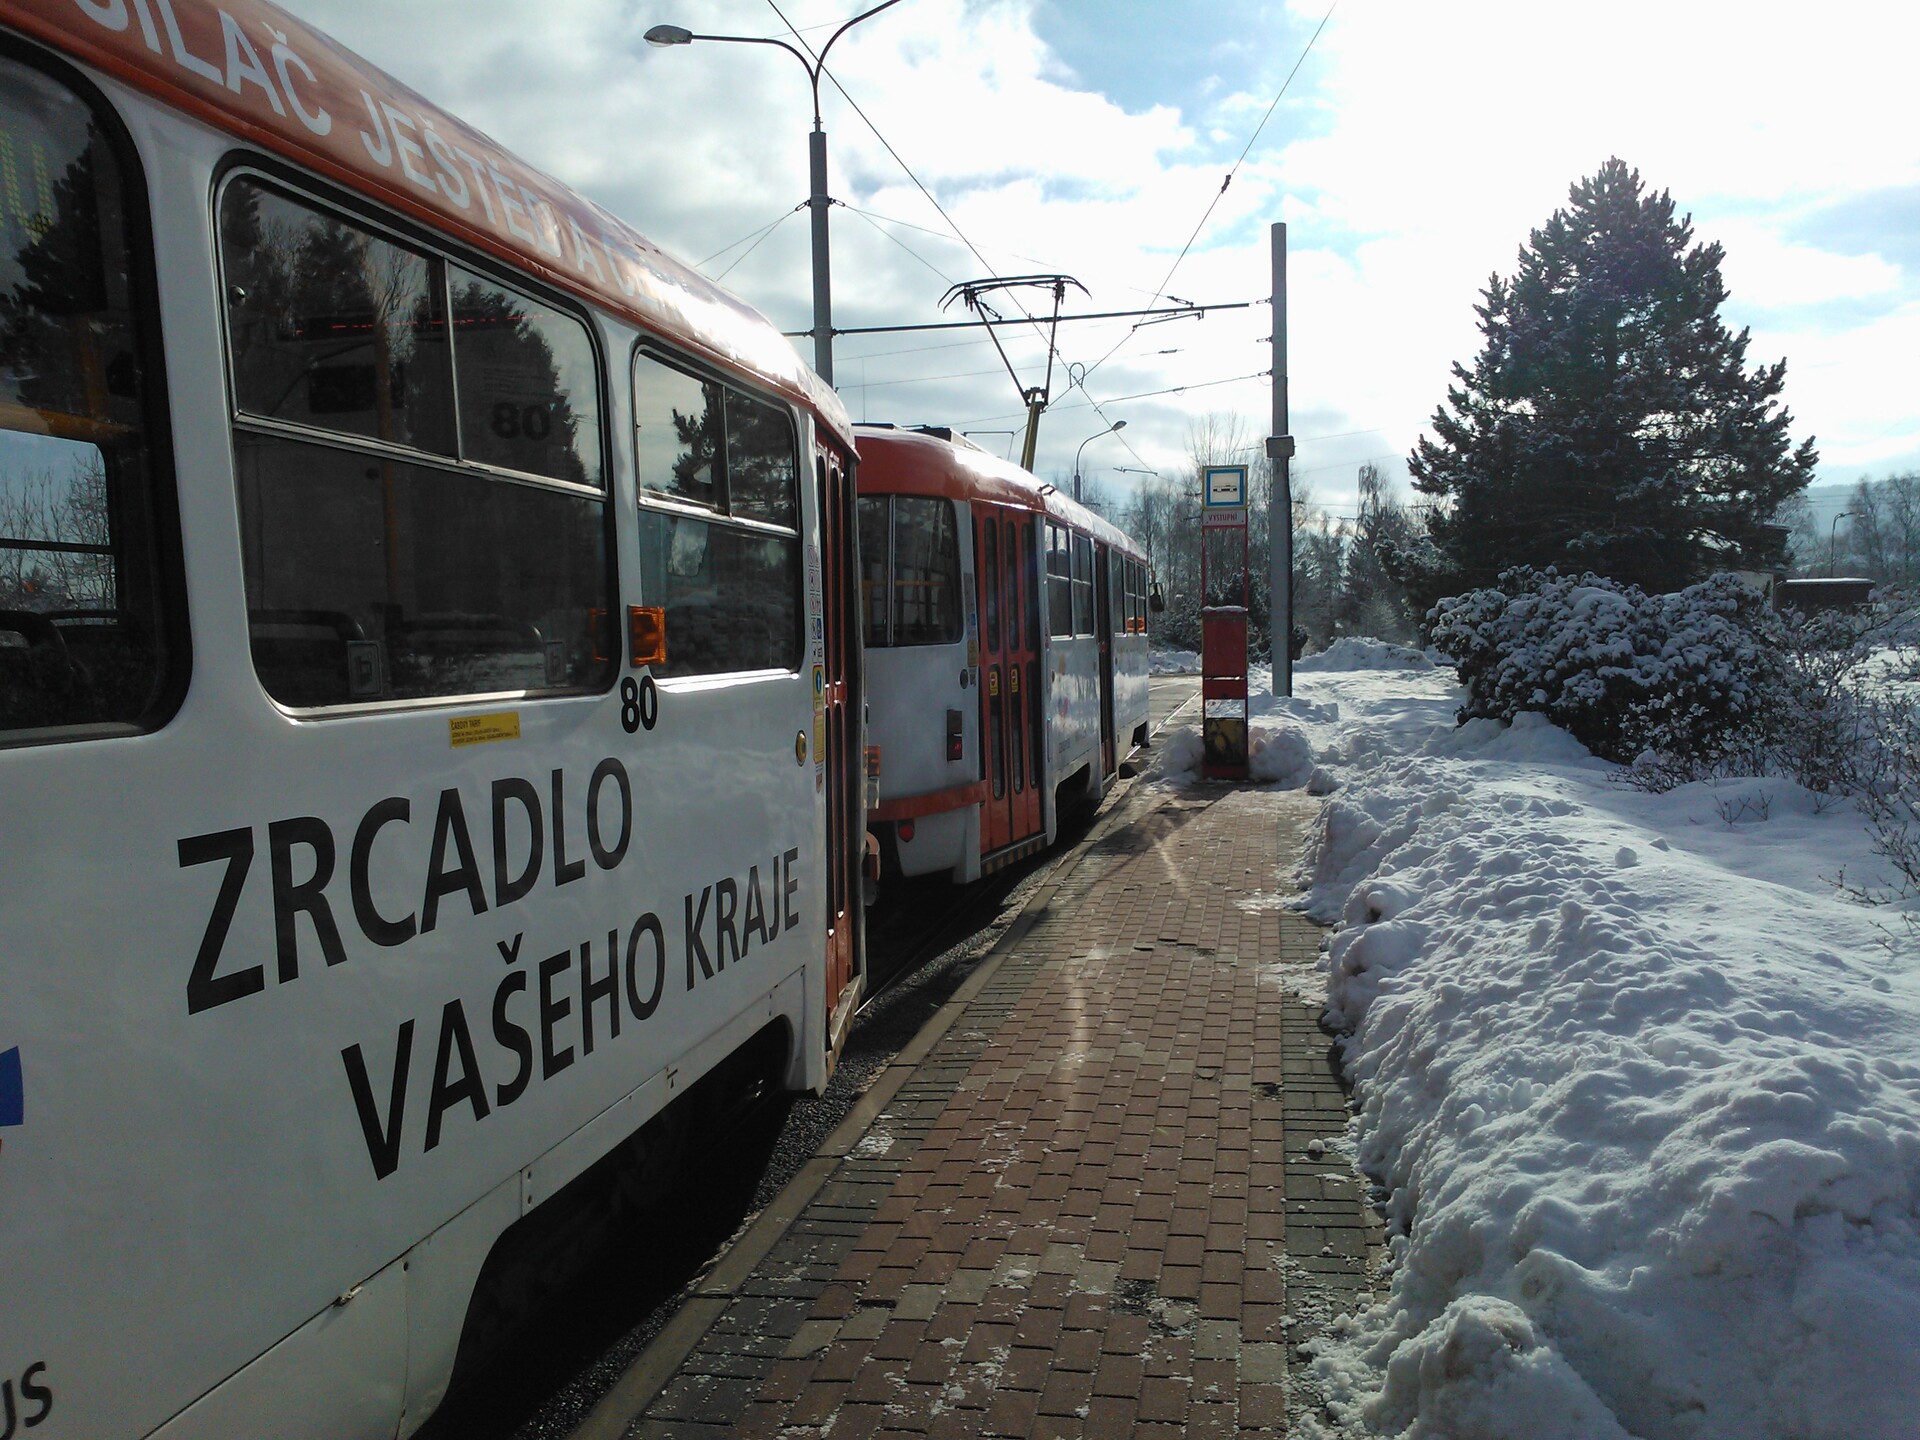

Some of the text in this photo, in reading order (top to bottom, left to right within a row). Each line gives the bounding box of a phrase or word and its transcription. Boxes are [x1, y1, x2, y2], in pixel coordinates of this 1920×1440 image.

[360, 89, 562, 258] JEŠTĚD
[491, 402, 551, 441] 80
[621, 677, 657, 734] 80
[177, 758, 632, 1015] ZRCADLO
[341, 847, 800, 1181] VAŠEHO KRAJE
